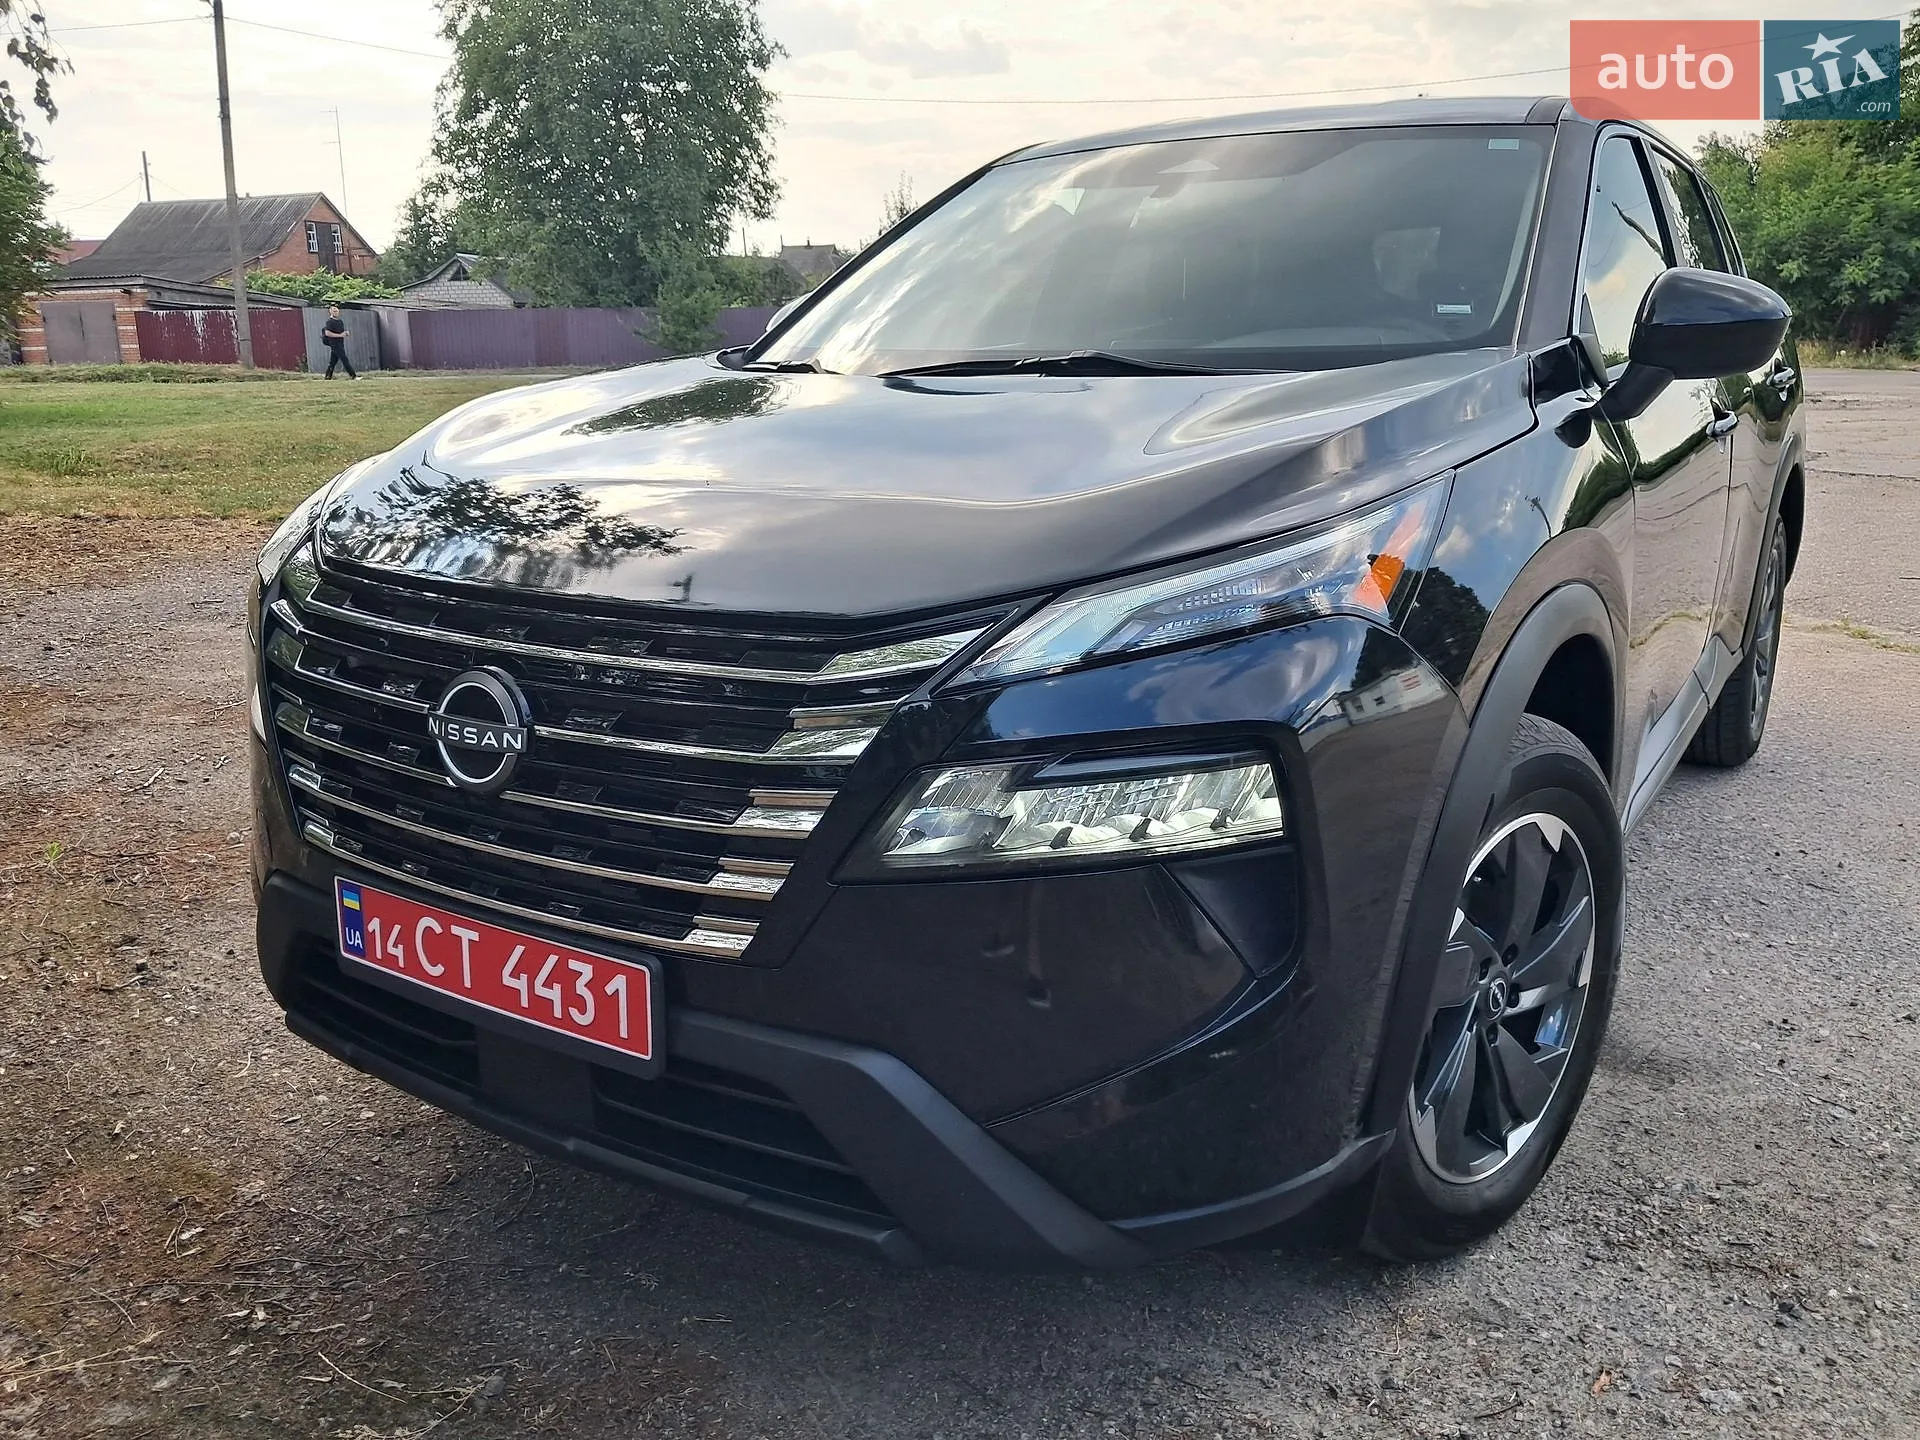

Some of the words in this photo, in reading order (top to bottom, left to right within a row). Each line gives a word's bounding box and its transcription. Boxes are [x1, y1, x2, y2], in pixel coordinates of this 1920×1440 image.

[428, 716, 522, 750] NISSAN
[345, 926, 364, 950] UA
[501, 944, 629, 1039] 4431
